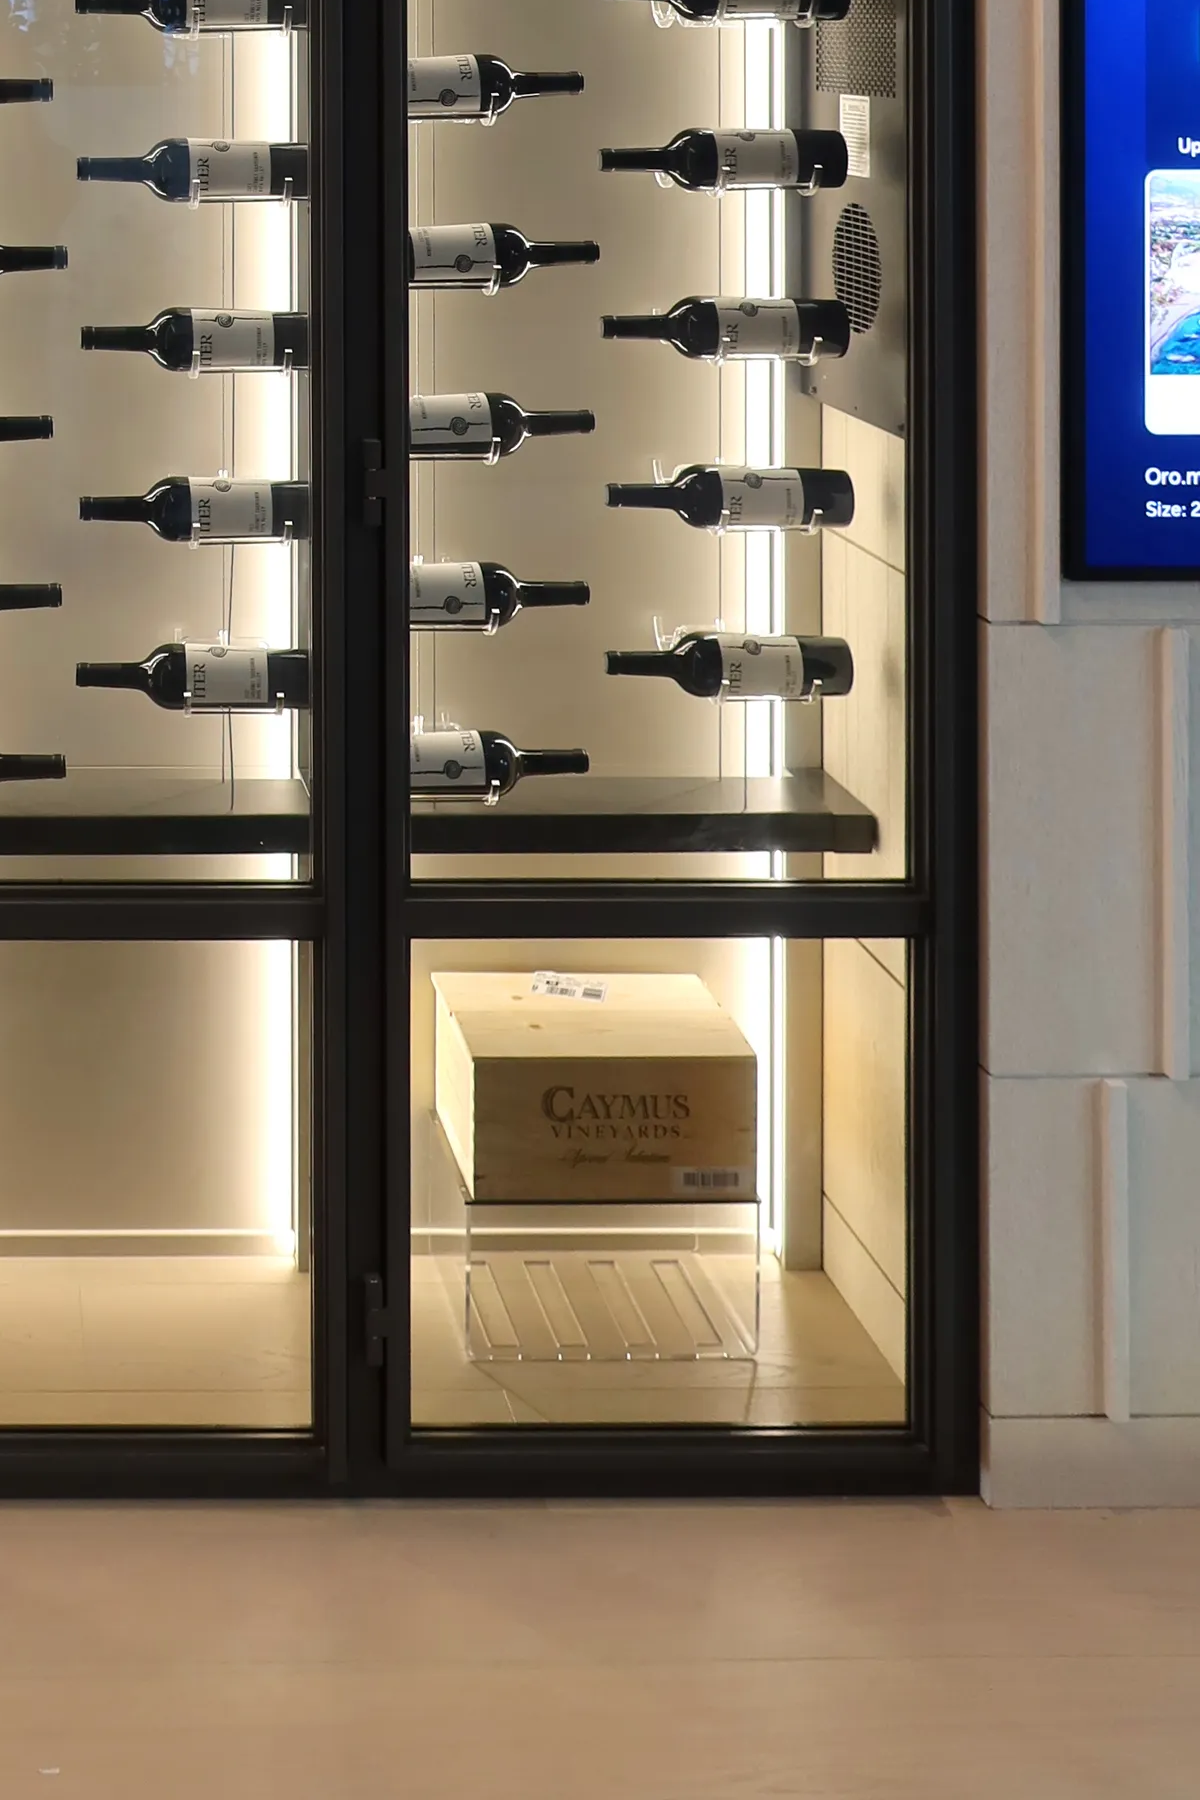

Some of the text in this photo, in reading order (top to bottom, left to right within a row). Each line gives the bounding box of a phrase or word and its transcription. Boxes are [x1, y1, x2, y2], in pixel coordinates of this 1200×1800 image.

[1178, 136, 1200, 158] Up
[197, 157, 209, 192] ITER
[199, 334, 212, 366] ITER
[1145, 467, 1200, 486] Oro.m
[198, 498, 210, 532] ITER
[1145, 500, 1187, 518] Size:
[193, 664, 206, 698] ITER
[541, 1086, 691, 1123] CAYMUS
[550, 1124, 681, 1139] VINEYARDS
